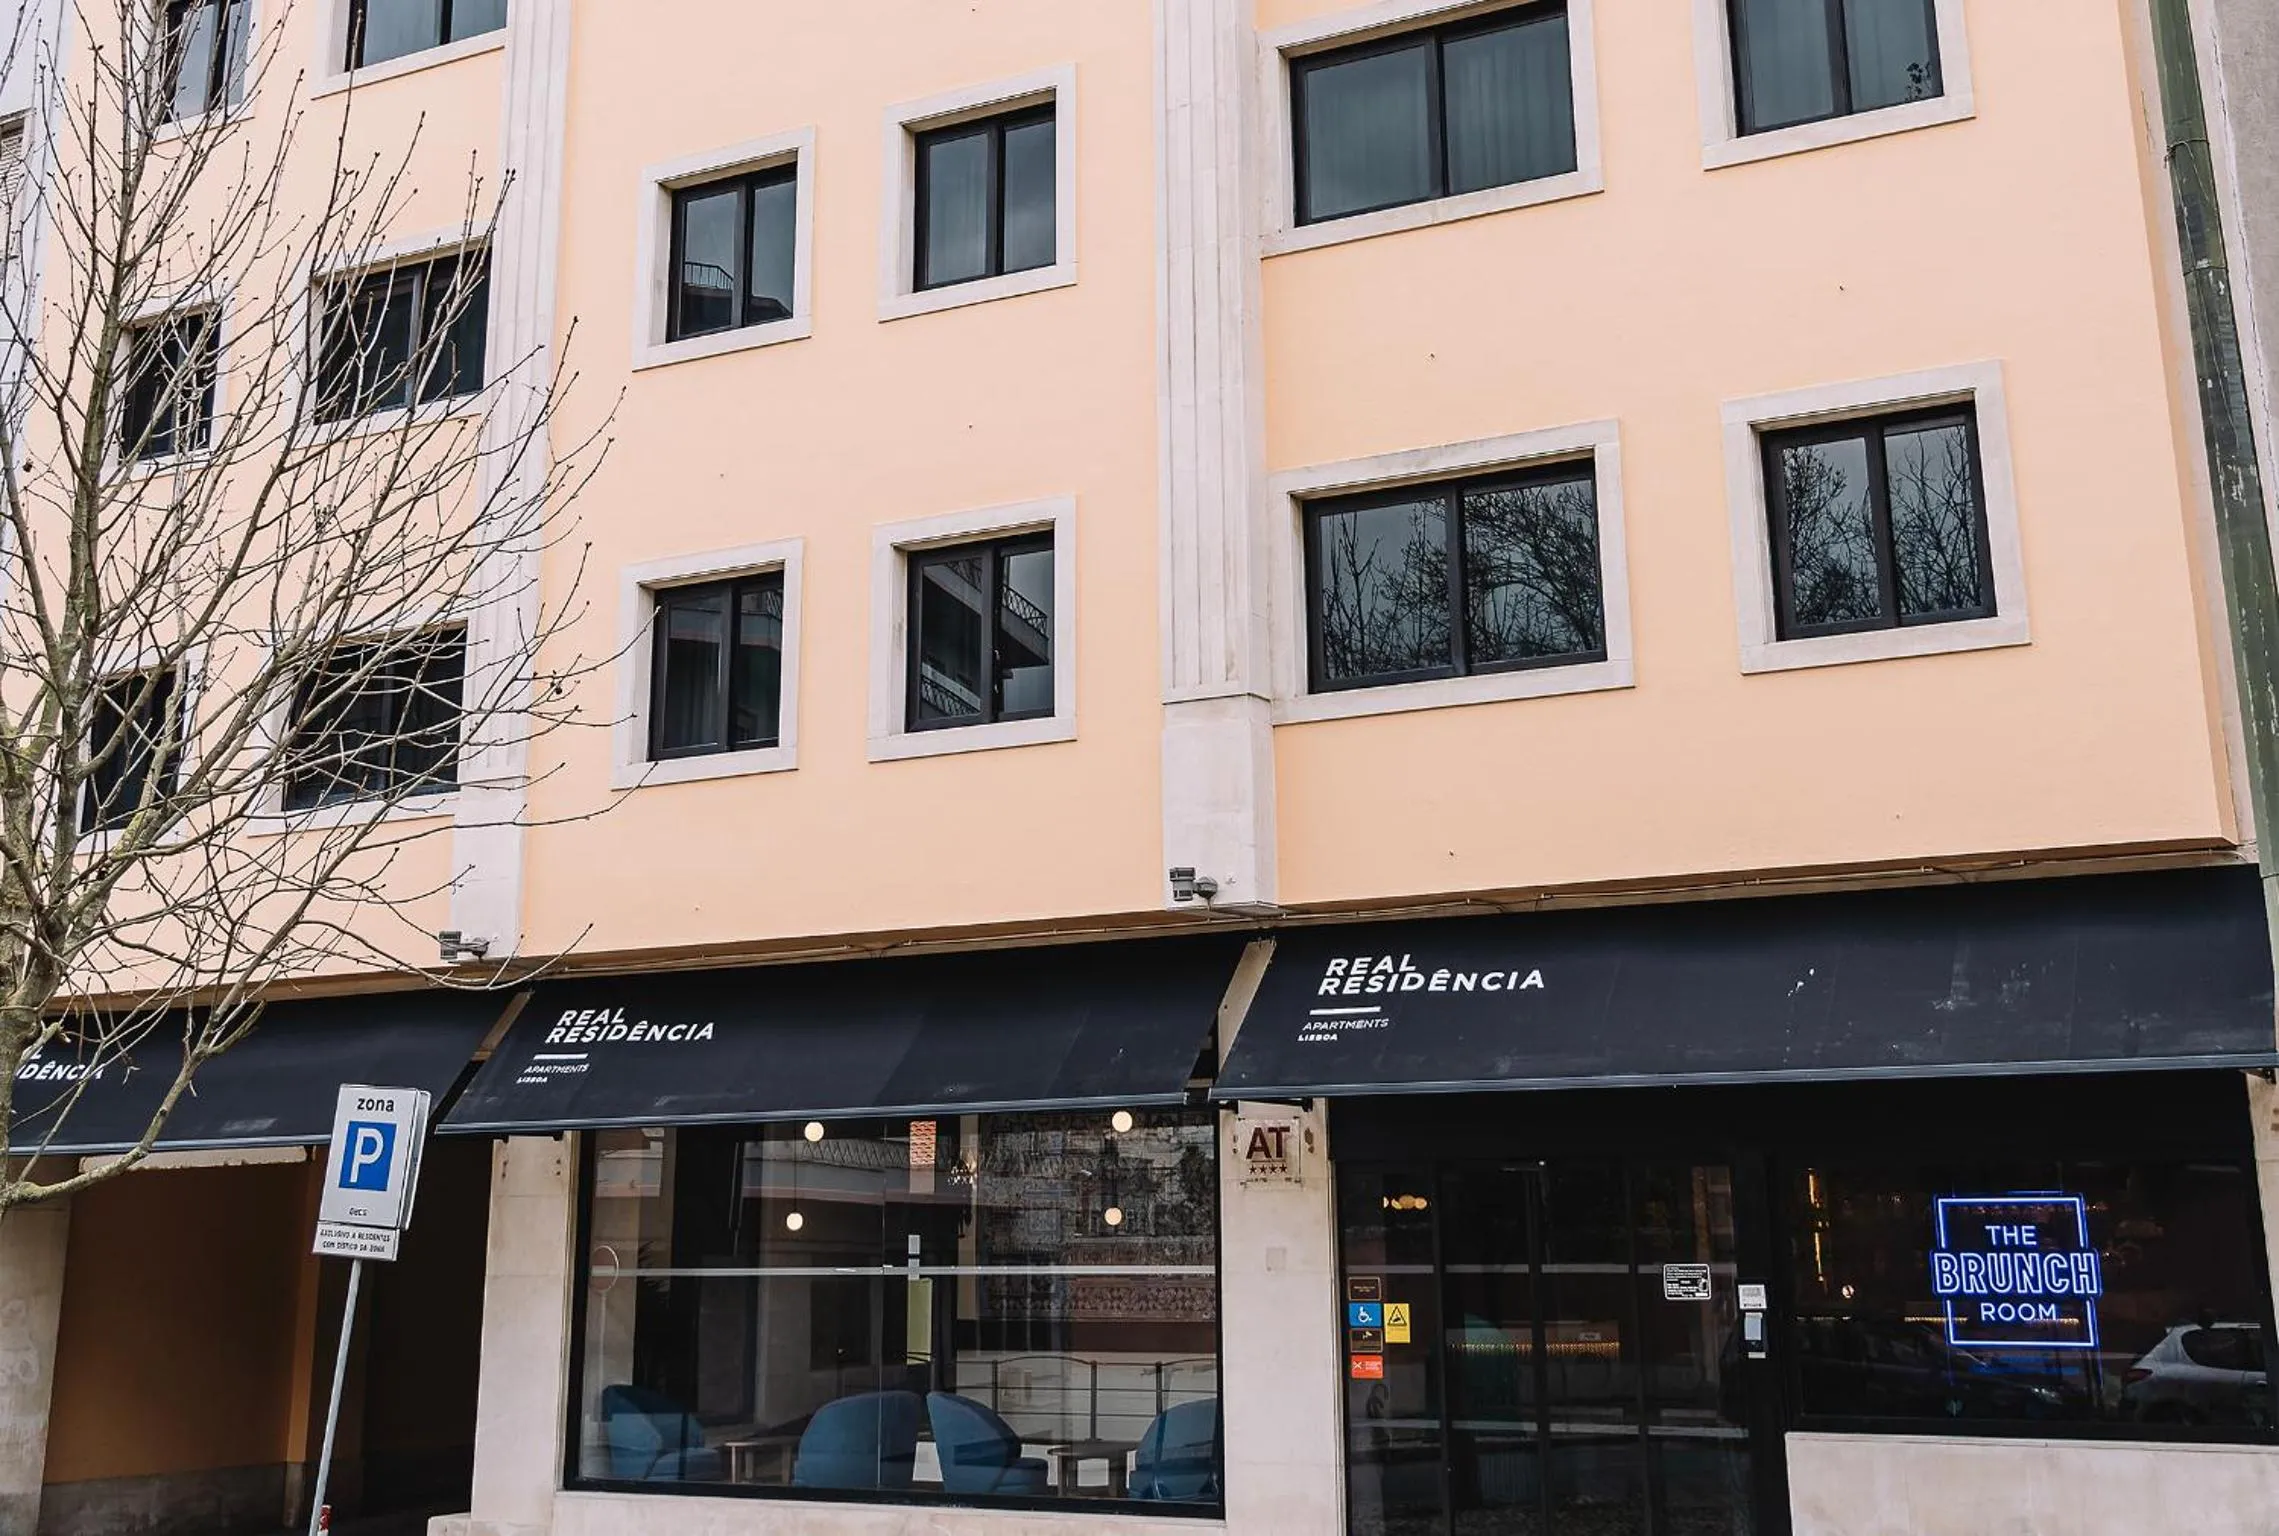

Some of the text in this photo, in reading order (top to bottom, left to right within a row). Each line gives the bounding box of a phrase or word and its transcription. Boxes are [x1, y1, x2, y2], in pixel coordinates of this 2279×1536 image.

[1325, 953, 1417, 977] REAL
[1317, 968, 1545, 996] RESIDÊNCIA
[556, 1007, 626, 1027] REAL
[1302, 1018, 1390, 1031] APARTMENTS
[544, 1020, 716, 1044] RESIDÊNCIA
[1297, 1033, 1339, 1042] LISBOA
[523, 1063, 590, 1074] APARTMENTS
[357, 1098, 395, 1112] zona
[1246, 1127, 1291, 1160] AT
[350, 1128, 384, 1183] P
[1985, 1225, 2037, 1246] THE
[1934, 1252, 2099, 1294] BRUNCH
[1981, 1303, 2057, 1322] ROOM
